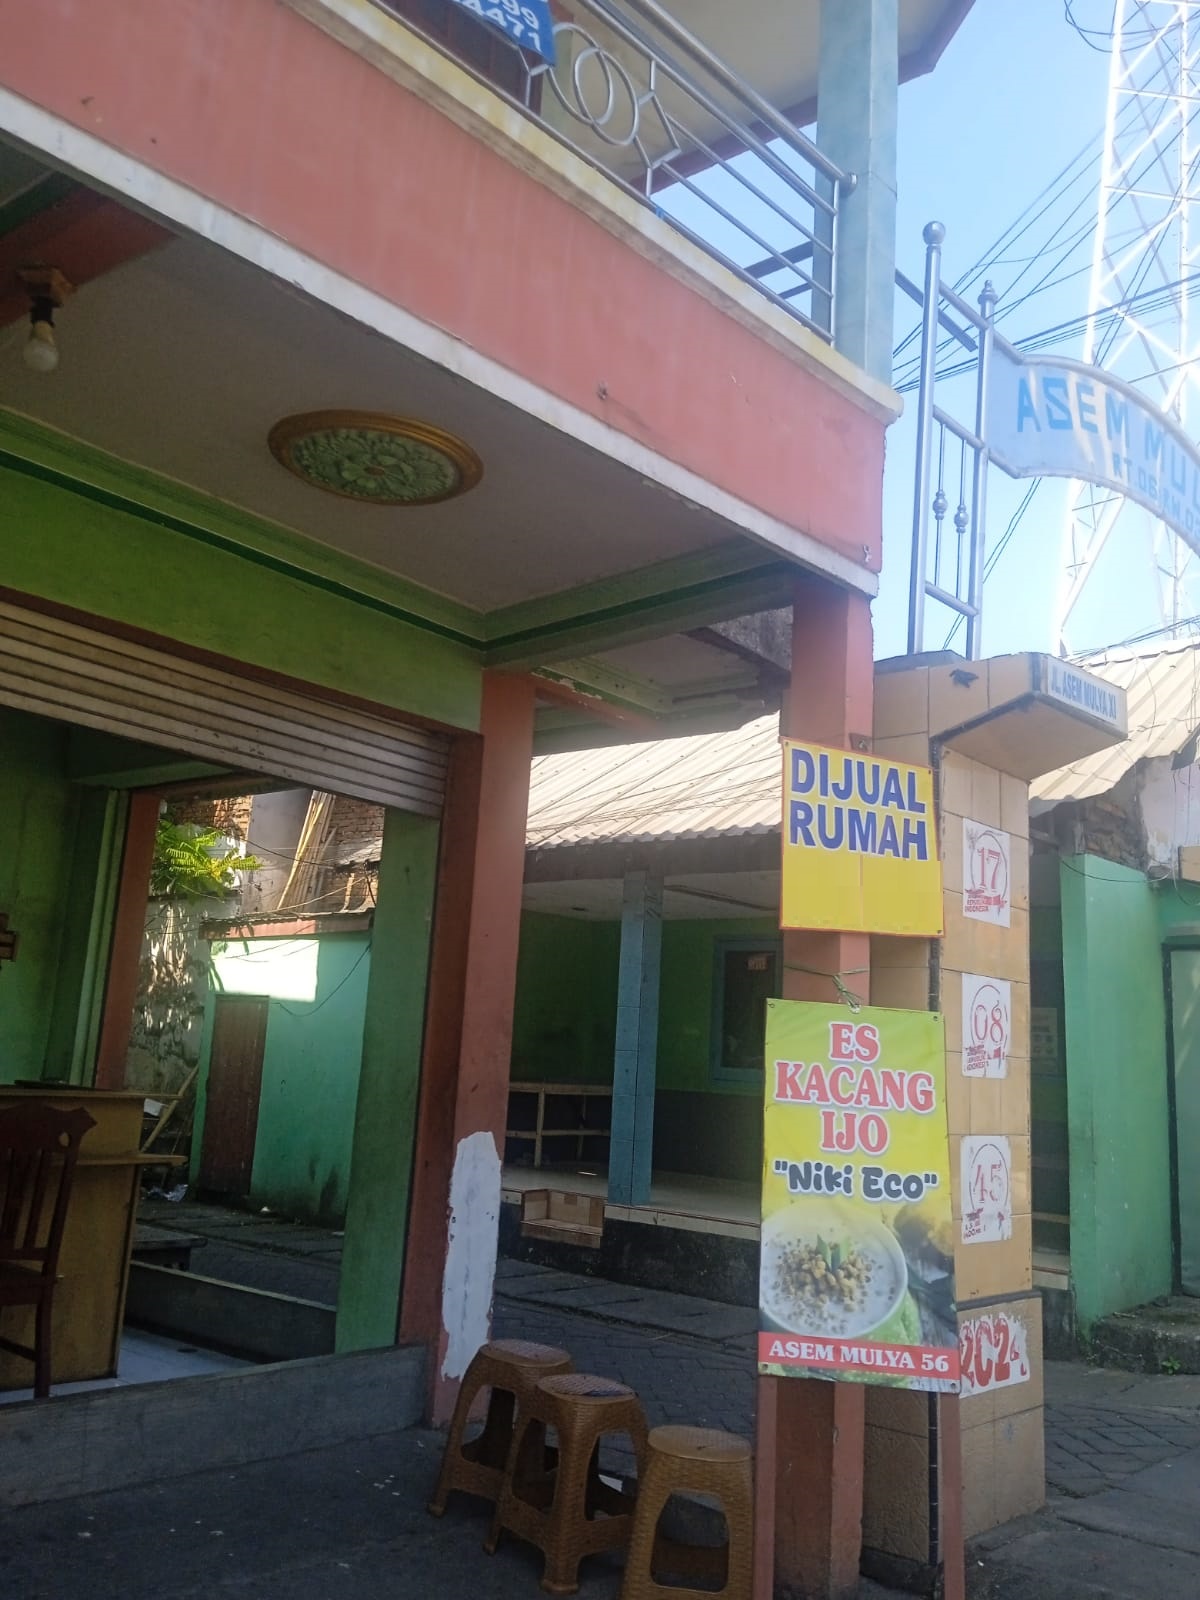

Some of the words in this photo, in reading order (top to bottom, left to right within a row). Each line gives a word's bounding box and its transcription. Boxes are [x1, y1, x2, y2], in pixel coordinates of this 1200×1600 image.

[487, 0, 540, 30] 99
[1017, 377, 1130, 448] ASEM
[1063, 671, 1082, 705] ASEM
[1084, 681, 1108, 717] MULYA
[791, 748, 926, 813] DIJUAL
[790, 800, 928, 861] RUMAH
[977, 847, 1001, 890] 17
[831, 1023, 879, 1062] ES
[974, 1000, 1004, 1043] 08
[776, 1062, 934, 1111] KACANG
[822, 1111, 888, 1153] IJO
[775, 1160, 853, 1194] "Niki
[862, 1167, 937, 1199] Eco"
[769, 1340, 834, 1362] ASEM
[840, 1345, 915, 1369] MULYA
[921, 1354, 949, 1372] 56
